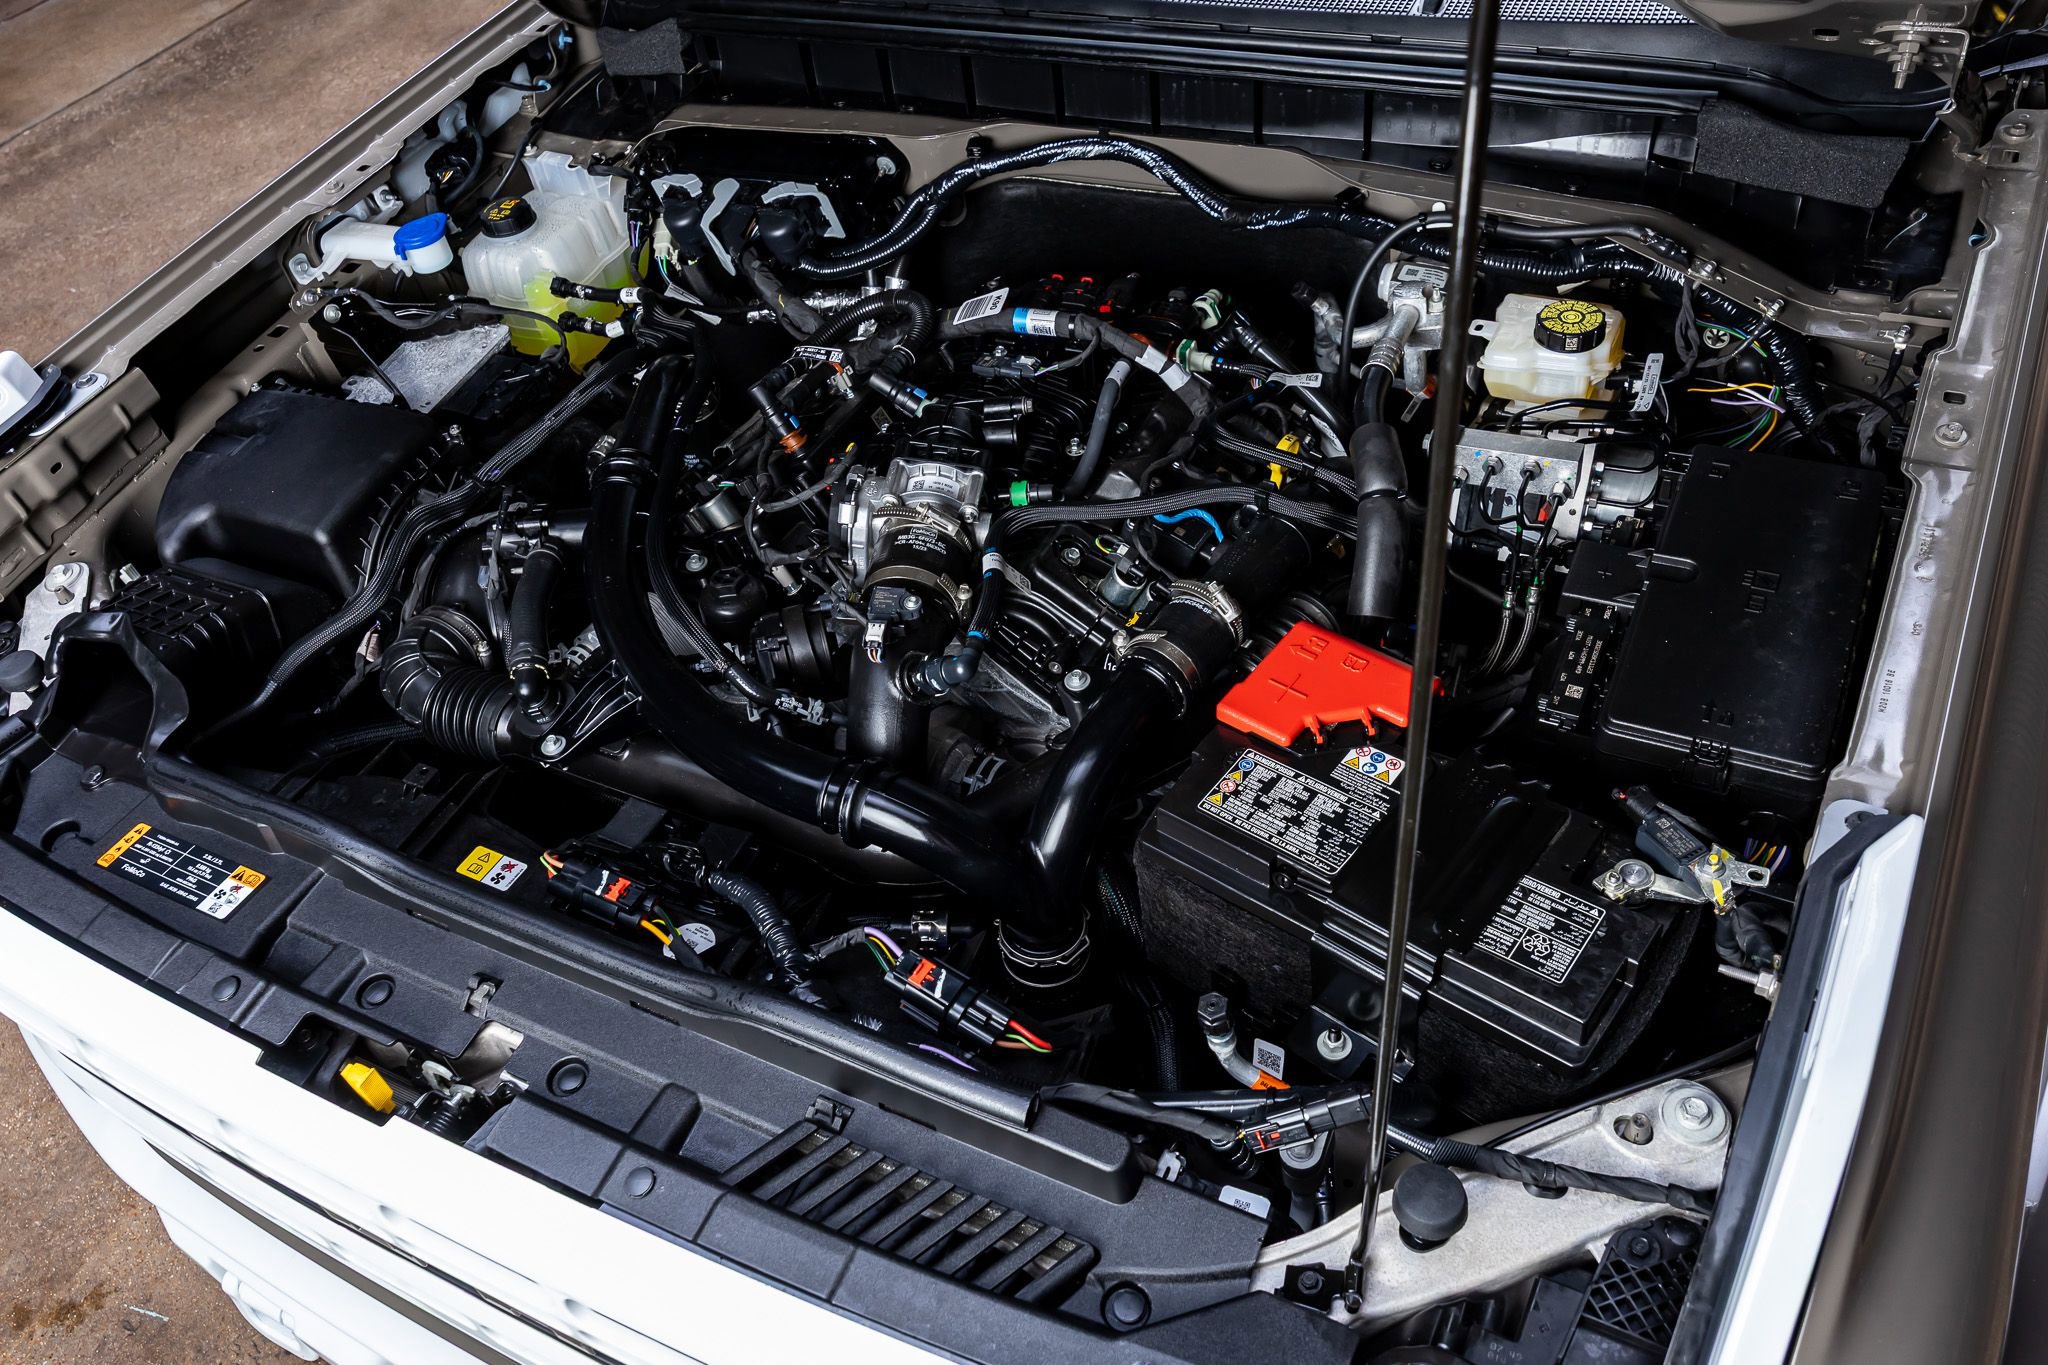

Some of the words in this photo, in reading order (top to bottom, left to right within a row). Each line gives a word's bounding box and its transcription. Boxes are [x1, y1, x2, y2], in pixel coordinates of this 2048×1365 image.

[1254, 754, 1295, 776] DANGER/POISON
[1305, 778, 1347, 801] PELIGRO/VENENO
[1219, 811, 1233, 821] OPEN.
[1284, 844, 1299, 854] ABRA.
[121, 863, 145, 877] FoMoCo
